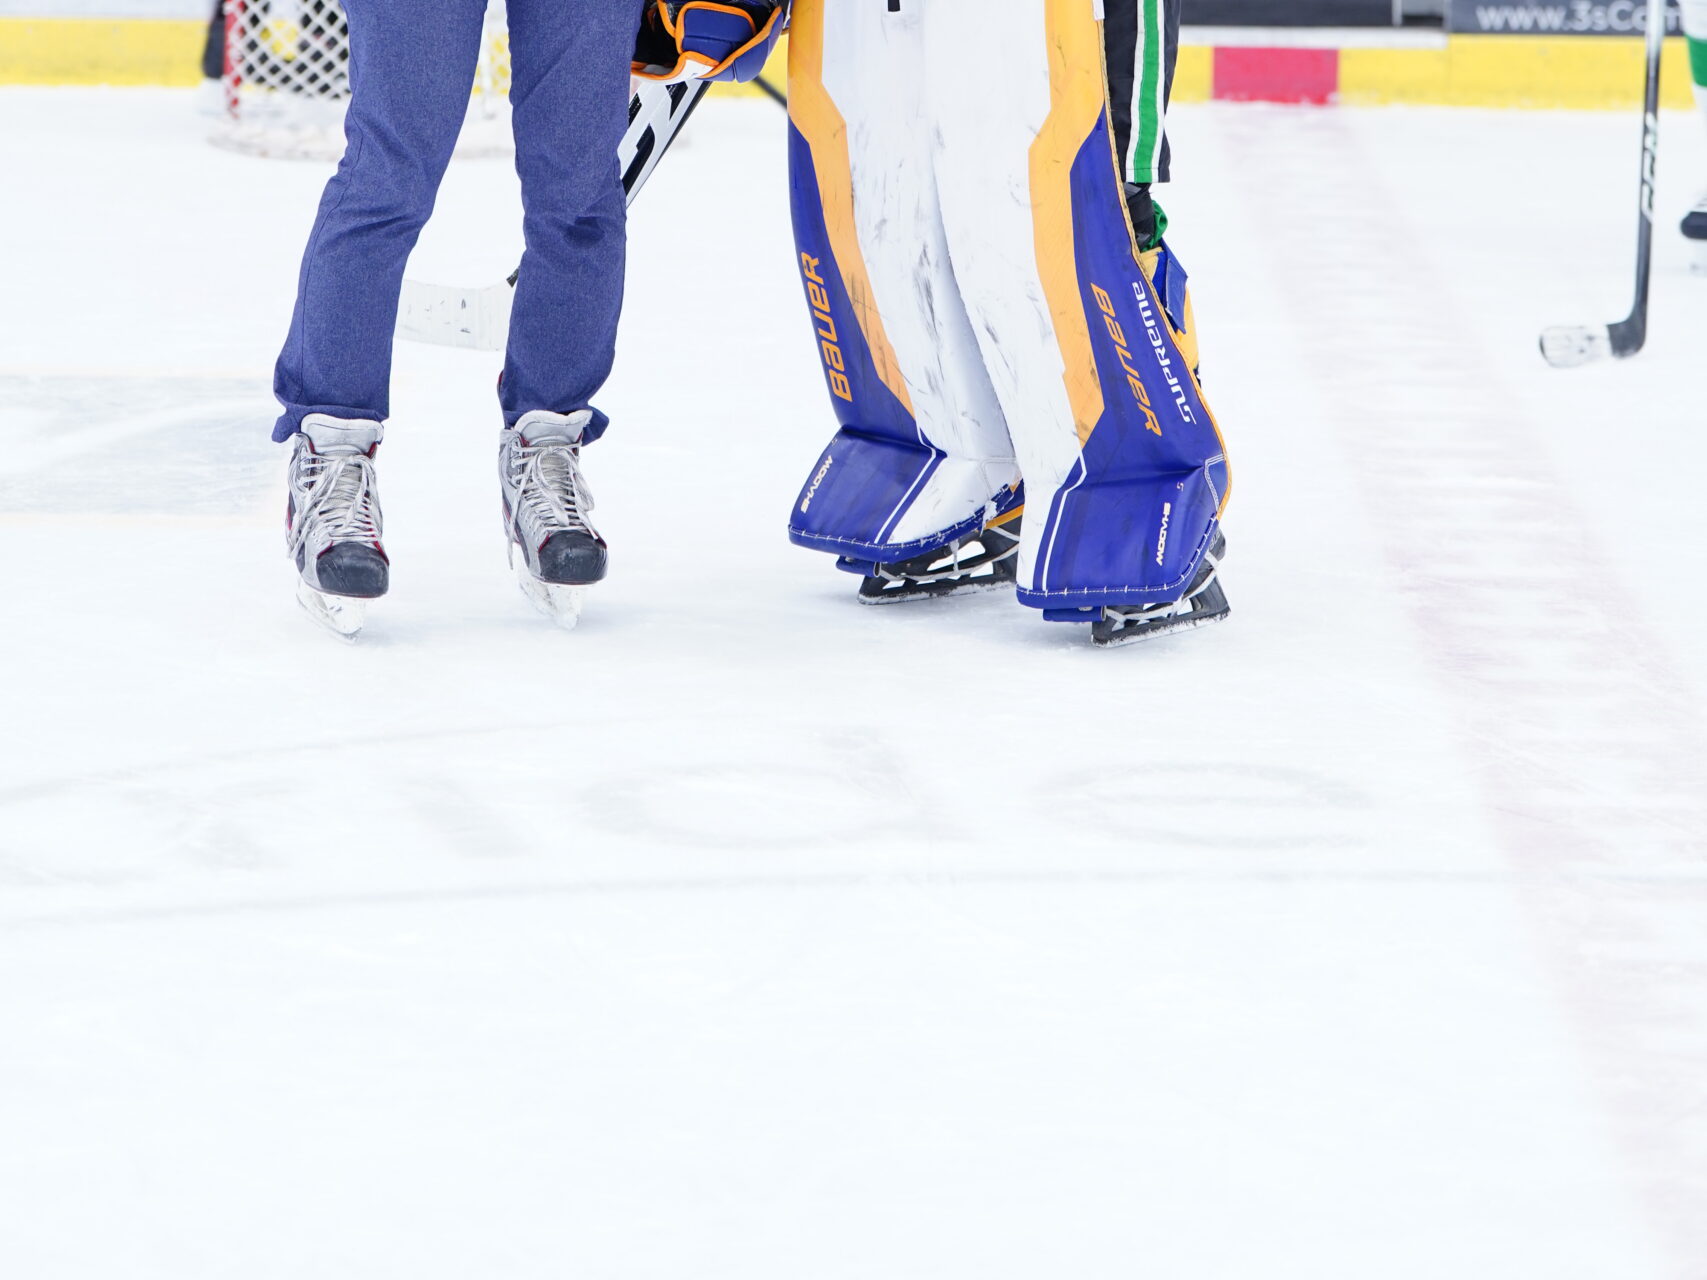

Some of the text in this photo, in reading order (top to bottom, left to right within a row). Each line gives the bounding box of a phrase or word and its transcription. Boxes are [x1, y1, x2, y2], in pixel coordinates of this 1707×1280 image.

[801, 252, 852, 402] BAUER
[1090, 282, 1162, 437] BAUER
[1132, 280, 1197, 425] SUPREME
[800, 455, 833, 514] SHADOW
[1156, 502, 1171, 567] SHADOW
